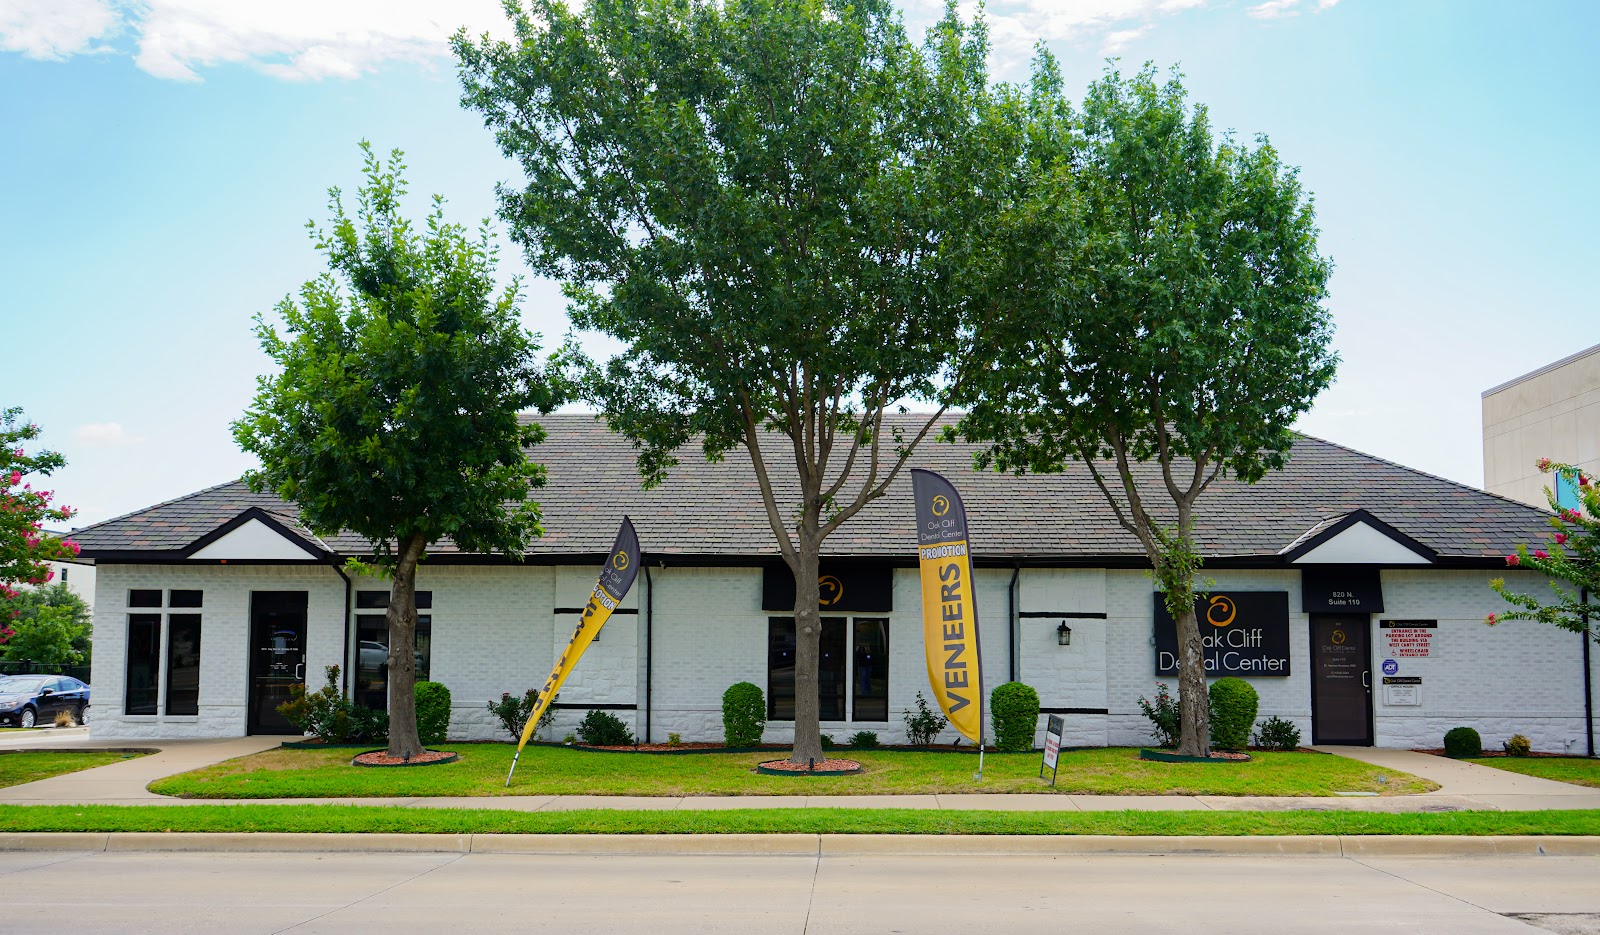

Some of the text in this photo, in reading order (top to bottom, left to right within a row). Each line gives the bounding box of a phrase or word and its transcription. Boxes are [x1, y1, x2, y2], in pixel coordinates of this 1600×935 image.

[927, 519, 955, 530] Oak Cliff
[921, 530, 963, 541] Dental Center
[921, 544, 966, 560] PROMOTION
[610, 572, 623, 585] Cliff
[939, 563, 971, 714] VENEERS
[1201, 628, 1263, 649] ak Cliff
[1222, 651, 1287, 671] Center
